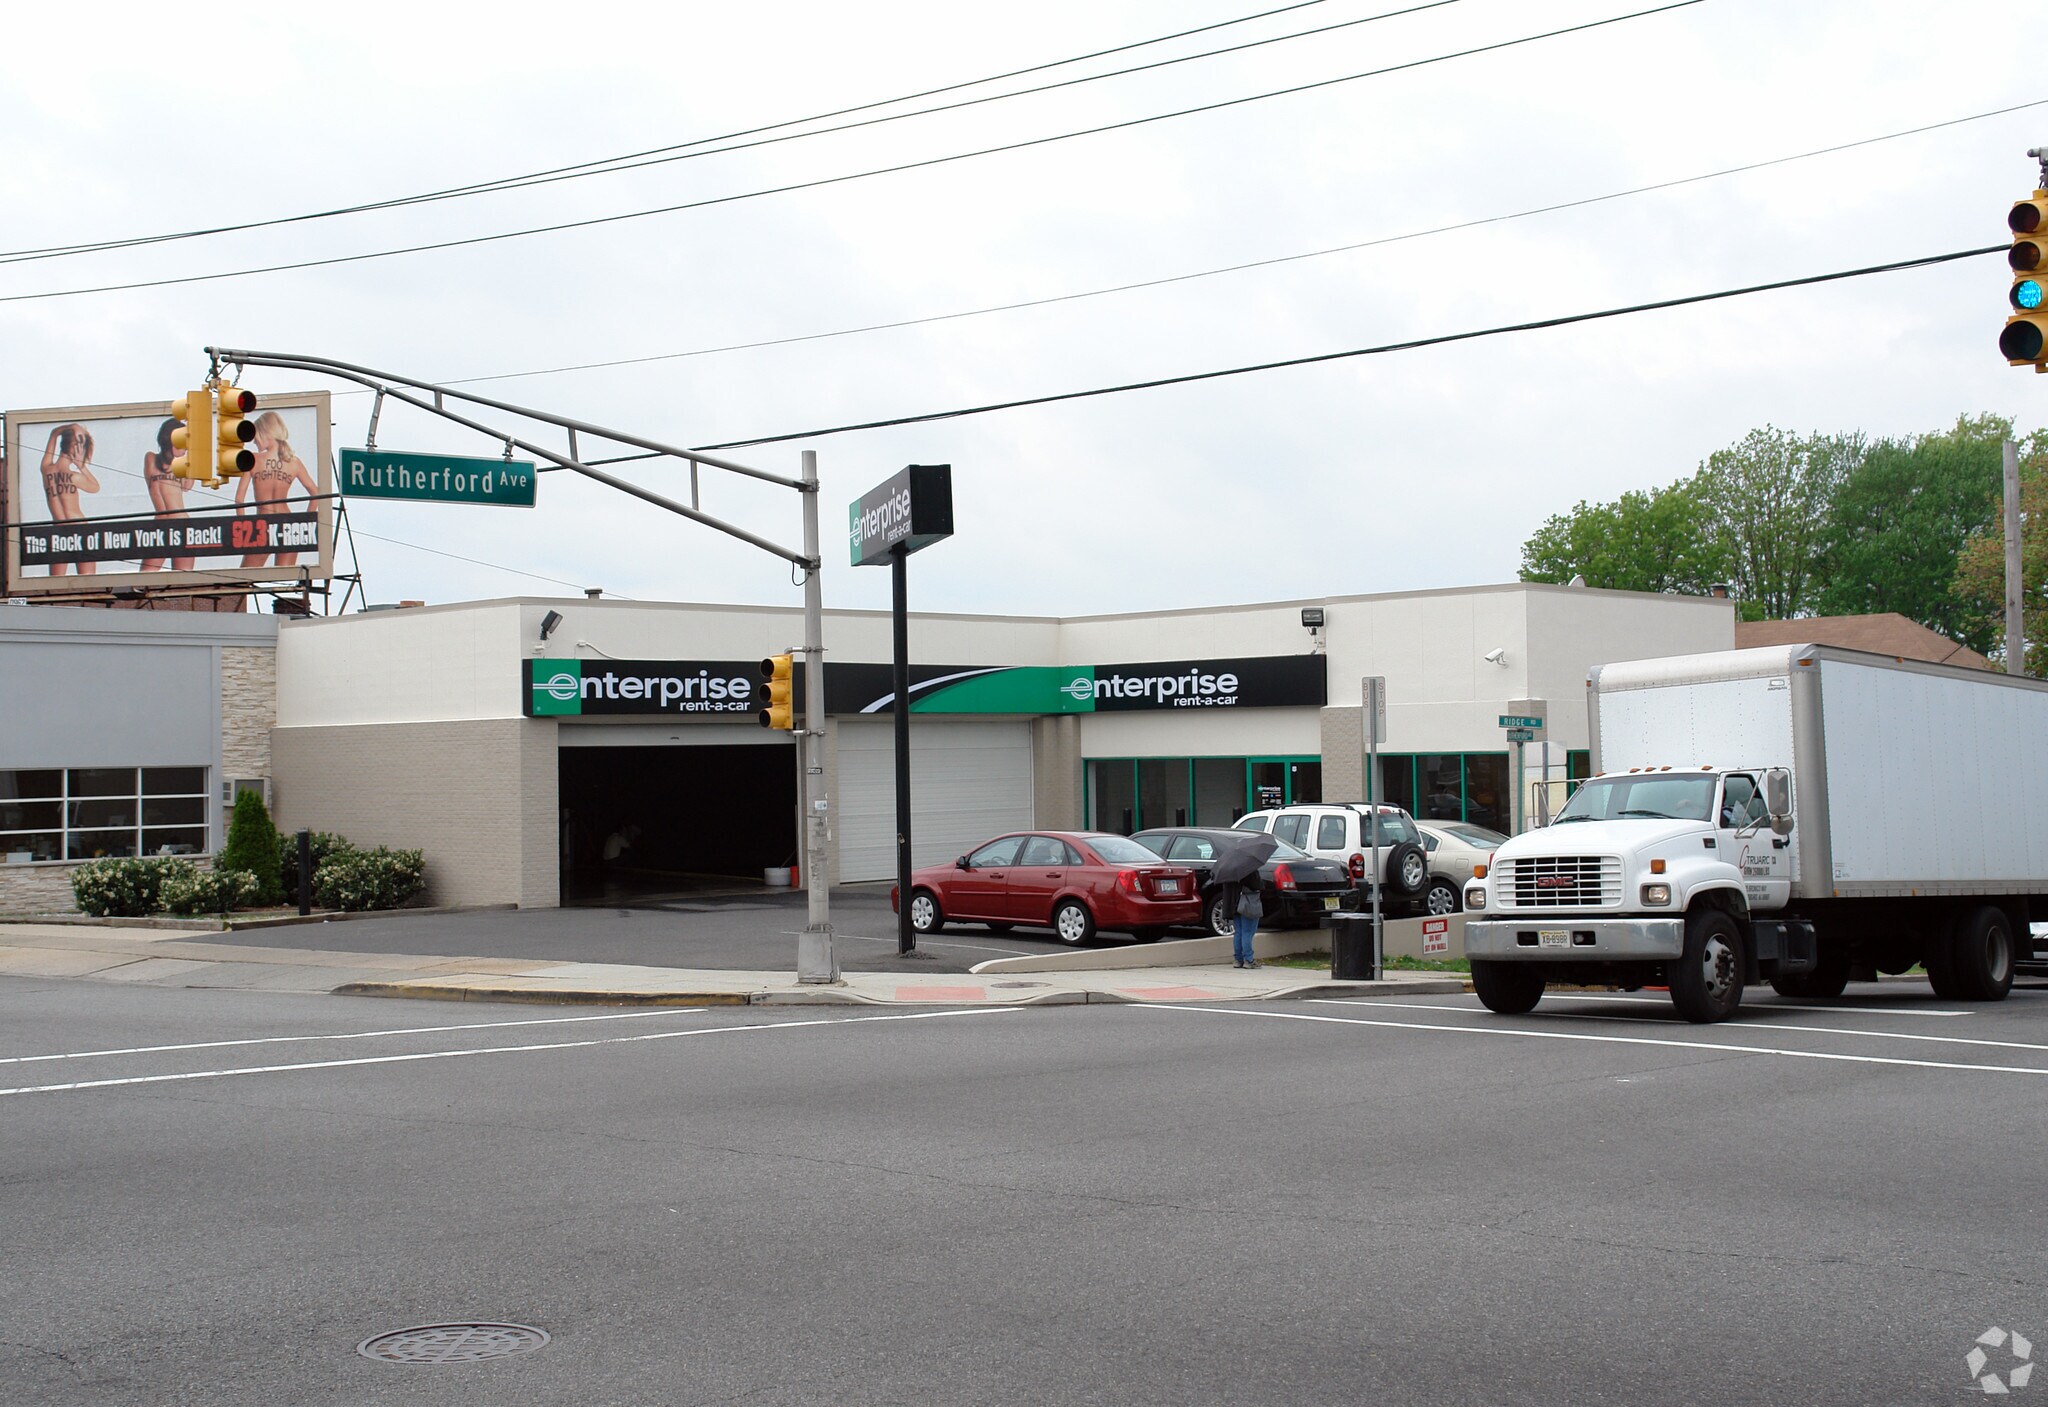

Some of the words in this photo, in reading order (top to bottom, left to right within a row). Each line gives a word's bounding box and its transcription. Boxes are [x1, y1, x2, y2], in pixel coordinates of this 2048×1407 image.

[266, 459, 283, 470] FOO
[47, 472, 73, 486] PINK
[254, 470, 293, 485] FIGHTERS
[351, 461, 493, 494] Rutherford
[500, 471, 527, 487] Ave
[47, 483, 77, 497] FLOYD
[850, 487, 910, 547] enterprise
[25, 535, 47, 554] The
[51, 533, 83, 553] Rock
[87, 532, 99, 550] of
[104, 531, 130, 549] New
[135, 528, 164, 547] York
[169, 528, 181, 546] is
[186, 526, 222, 546] Back!
[232, 519, 267, 549] 92.3
[887, 519, 912, 542] rent-a-car
[533, 670, 751, 707] enterprise
[1060, 668, 1239, 703] enterprise
[680, 700, 751, 711] rent-a-car
[1174, 694, 1239, 706] rent-a-car
[1504, 717, 1525, 726] RIDGE
[1538, 876, 1574, 887] GMC
